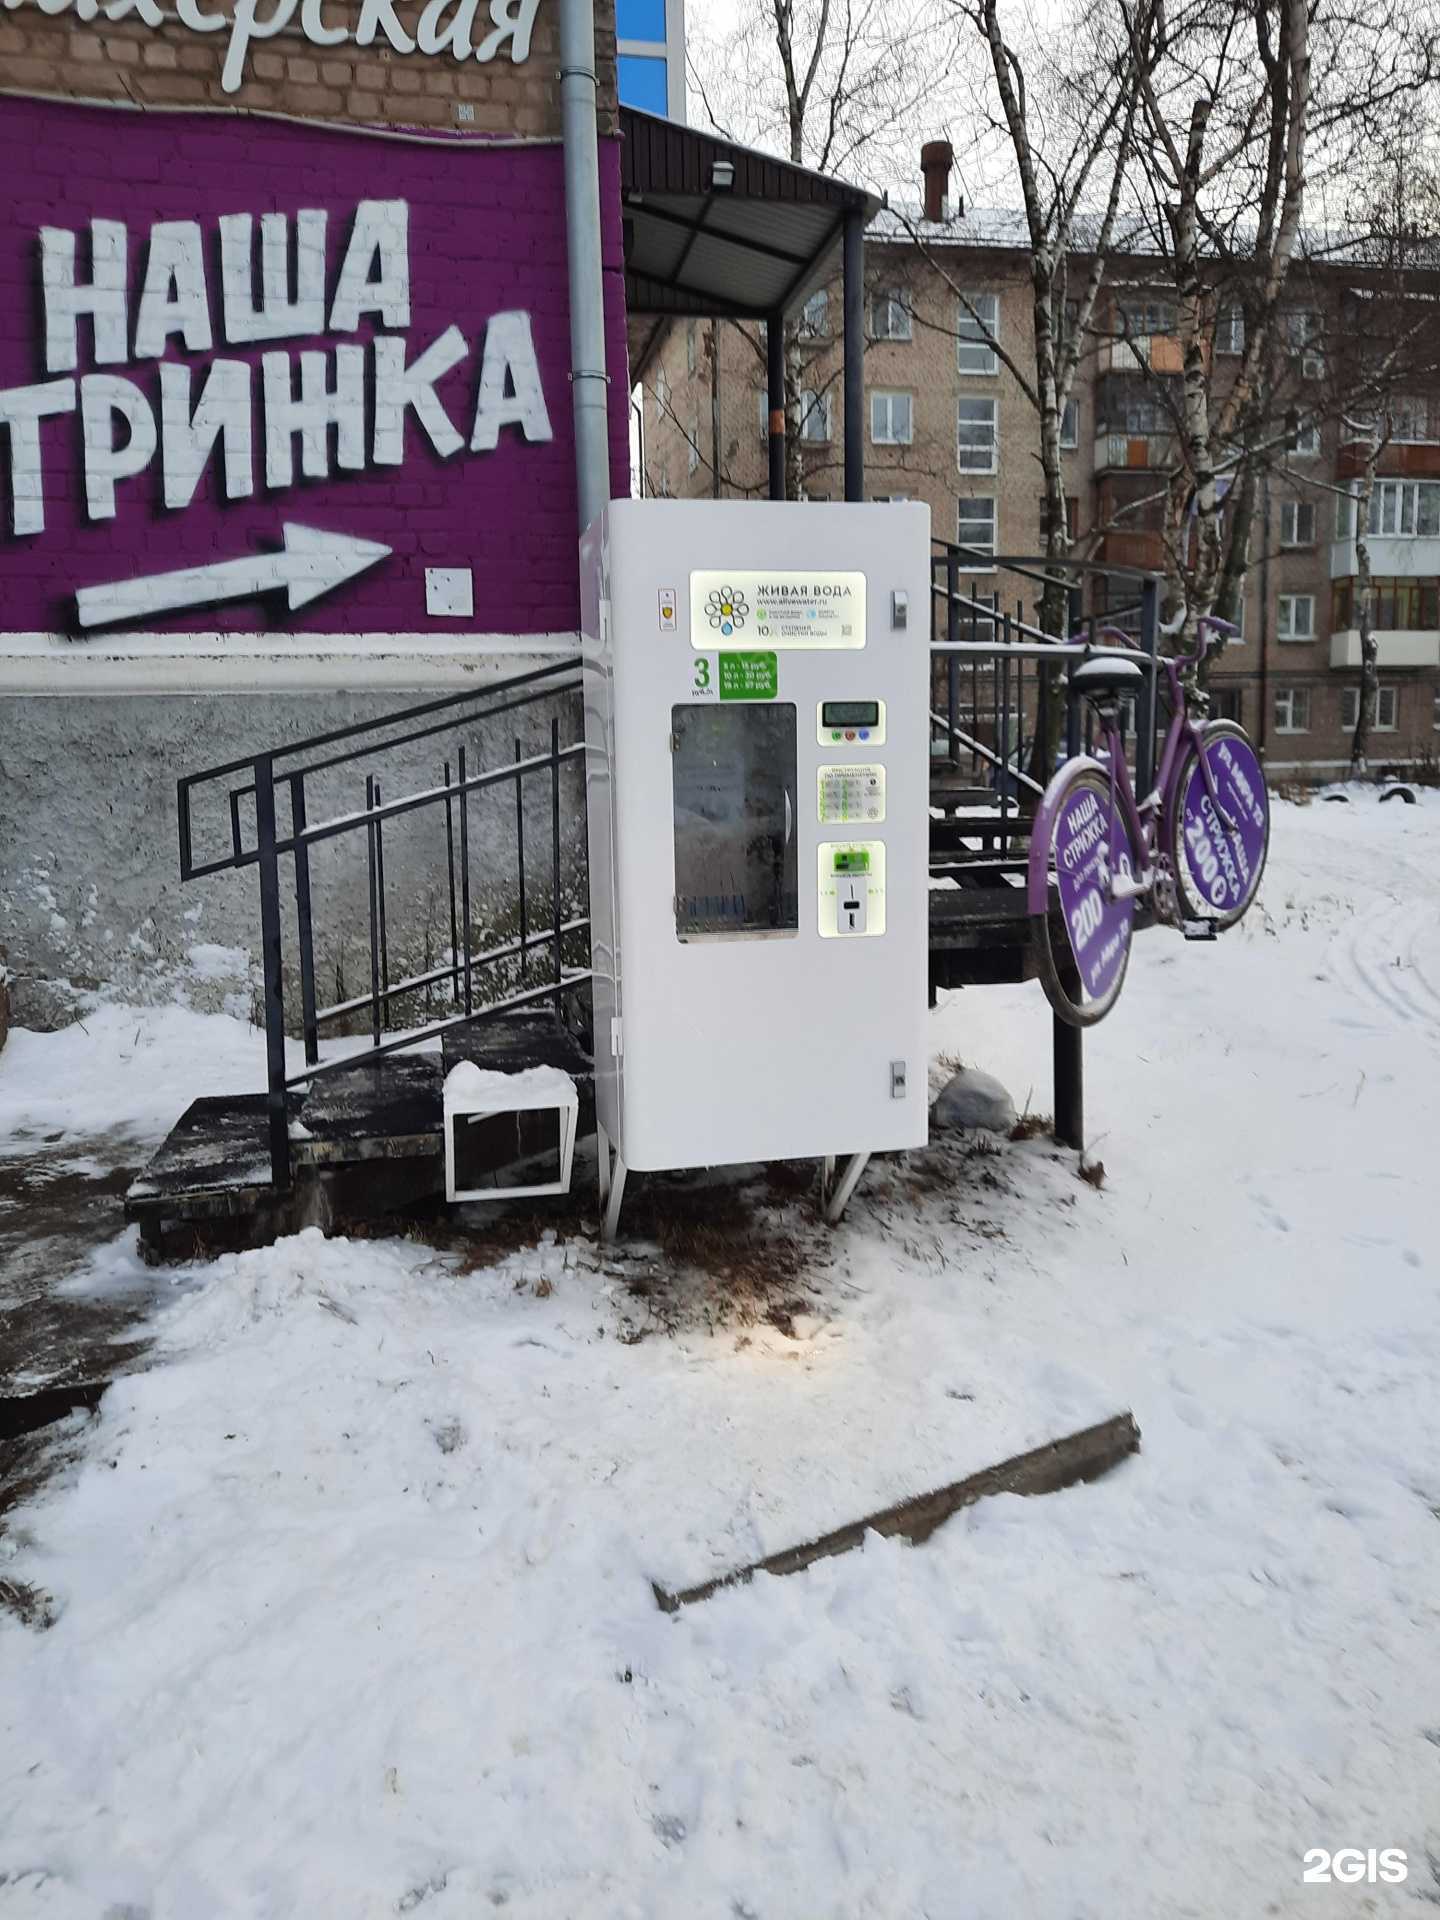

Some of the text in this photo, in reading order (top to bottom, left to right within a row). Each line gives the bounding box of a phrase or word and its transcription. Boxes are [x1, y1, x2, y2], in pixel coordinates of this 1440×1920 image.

[40, 198, 411, 373] НАША
[757, 585, 852, 598] ЖИВАЯ ВОДА
[694, 658, 710, 688] 3
[1067, 793, 1099, 836] НАША
[1063, 812, 1109, 870] СТРИЖКА
[1201, 795, 1240, 902] СТРИЖКА
